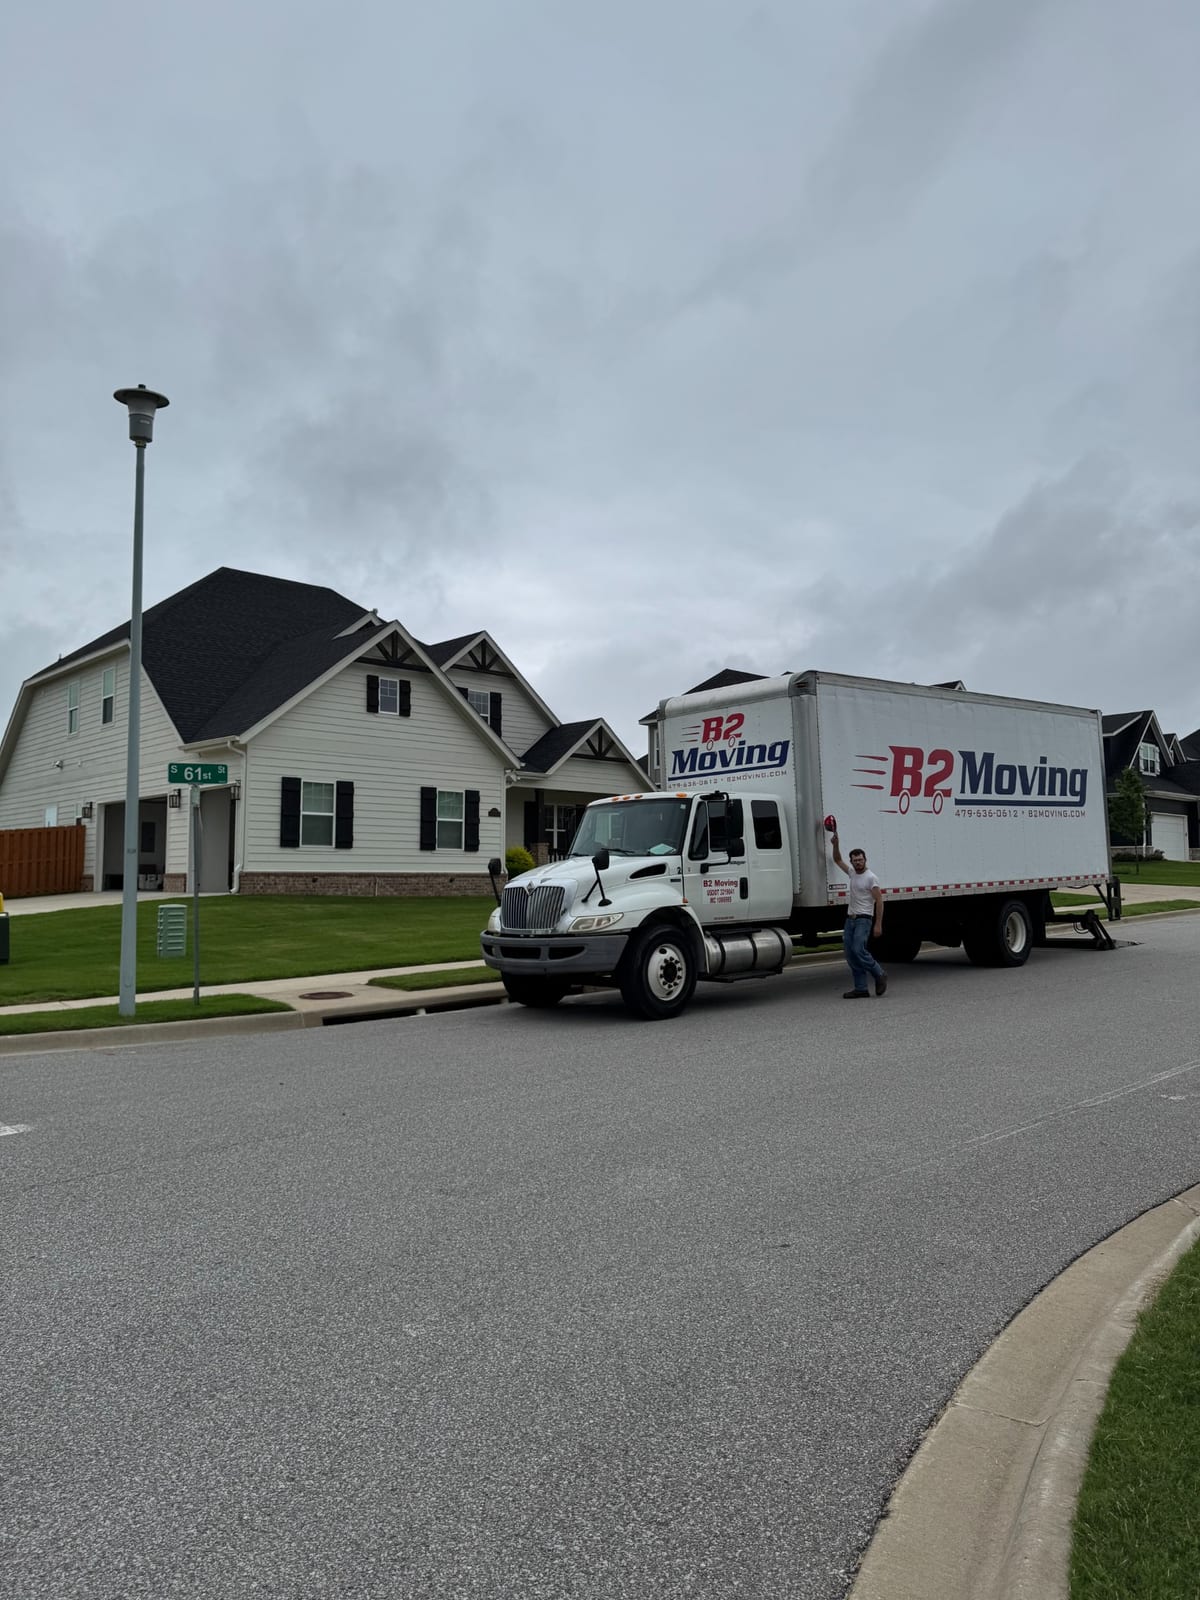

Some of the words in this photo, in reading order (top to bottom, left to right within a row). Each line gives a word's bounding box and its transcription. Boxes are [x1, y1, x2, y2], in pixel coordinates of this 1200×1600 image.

[702, 713, 745, 744] B2
[672, 740, 790, 775] Moving
[170, 765, 178, 774] S
[184, 767, 211, 780] 61st
[217, 766, 226, 774] St
[726, 770, 787, 783] B2MOVING.COM
[888, 746, 954, 798] B2
[957, 750, 1088, 807] Moving
[955, 809, 1018, 817] 479-636-0612
[1028, 809, 1086, 819] B2MOVING.COM
[703, 879, 712, 888] B2
[714, 879, 738, 888] Moving
